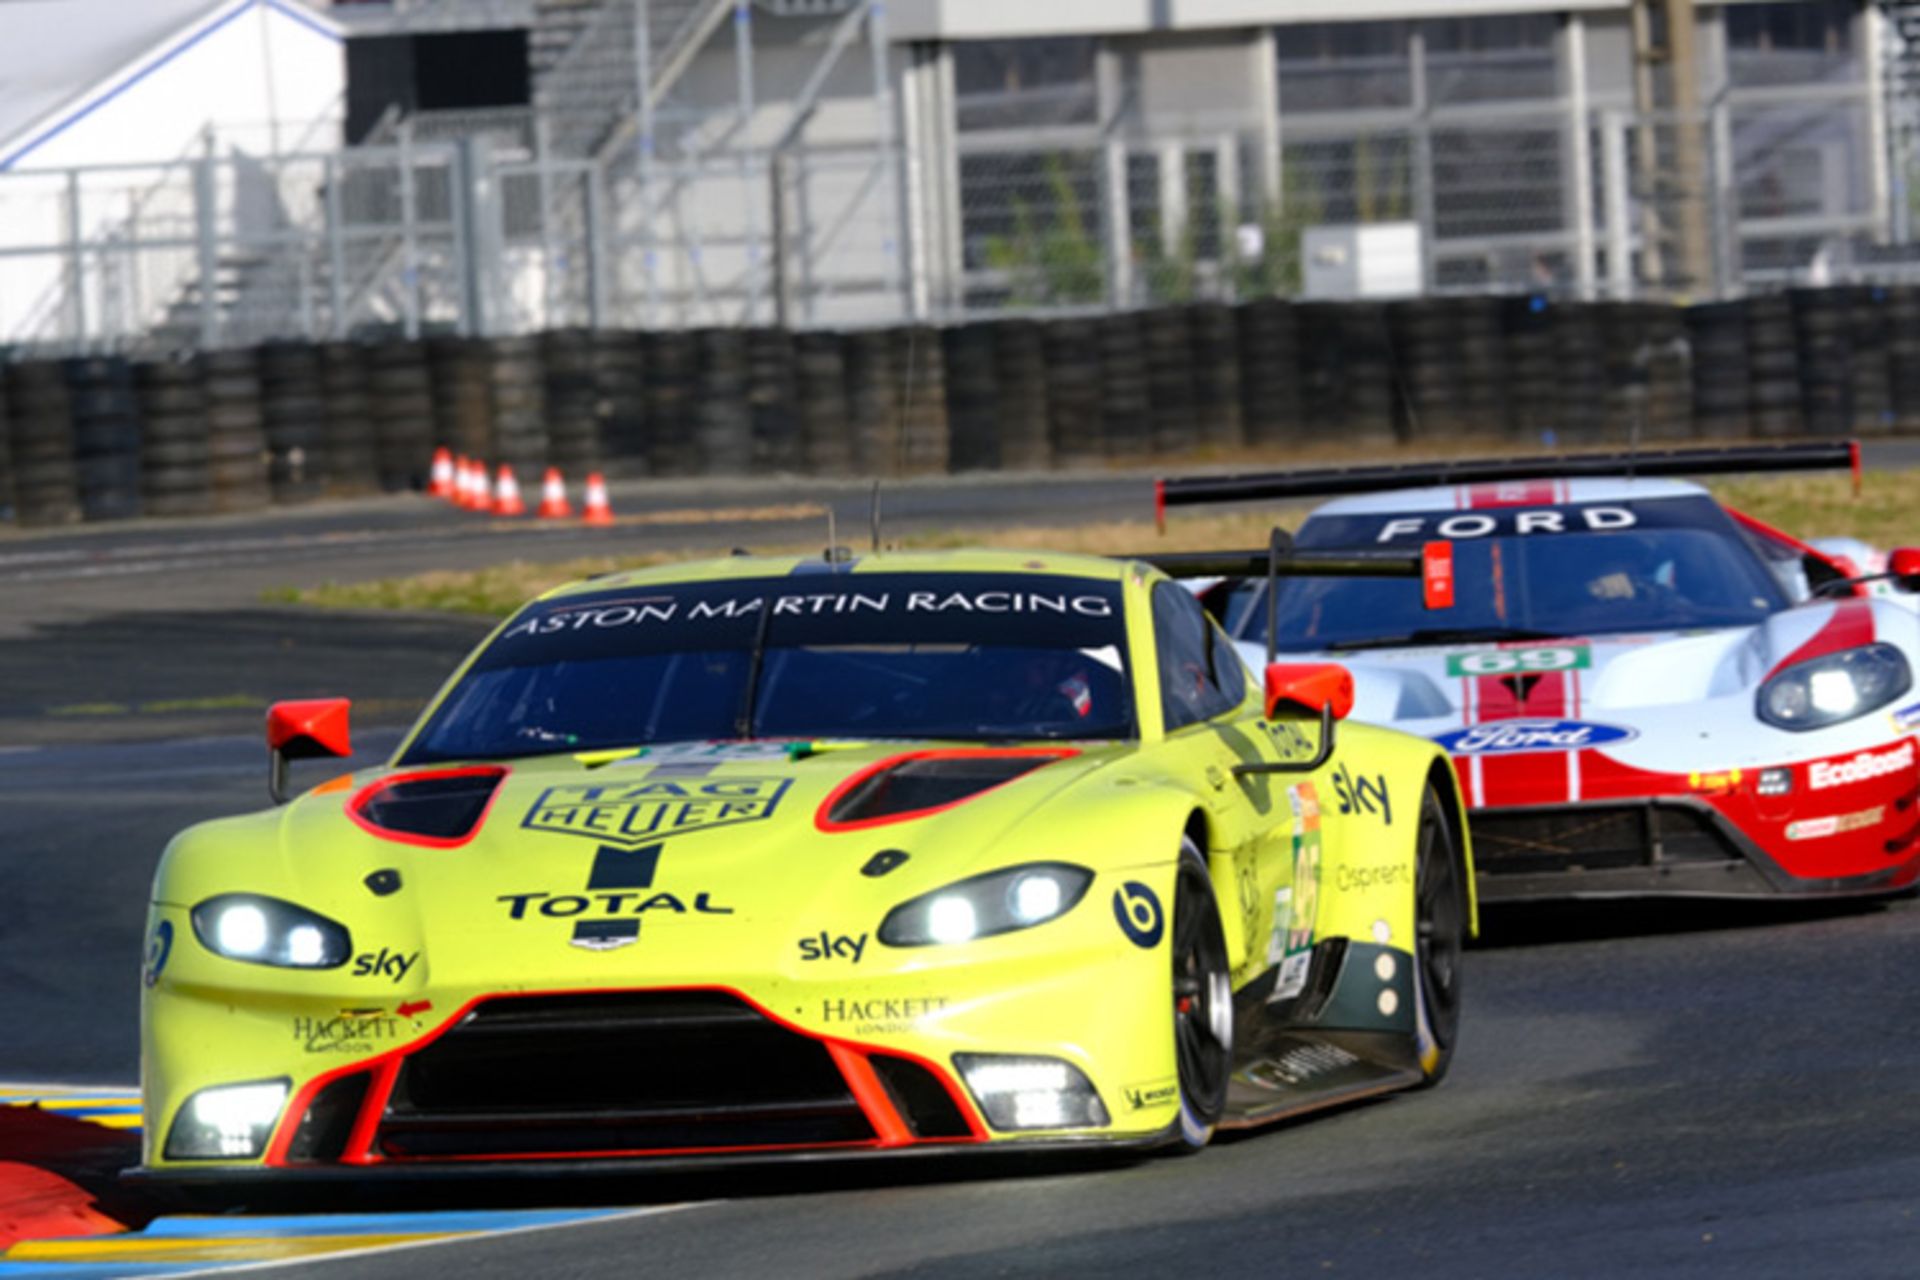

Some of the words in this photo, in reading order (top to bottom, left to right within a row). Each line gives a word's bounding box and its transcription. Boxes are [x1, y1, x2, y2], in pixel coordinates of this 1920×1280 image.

[1377, 507, 1637, 542] FORD
[503, 602, 676, 639] ASTON
[688, 592, 889, 619] MARTIN
[906, 592, 1112, 616] RACING
[1459, 649, 1575, 671] 69
[1456, 721, 1592, 750] Ford
[551, 782, 760, 799] TAG
[1333, 762, 1392, 825] sky
[541, 802, 757, 835] HEUER
[496, 892, 734, 920] TOTAL
[798, 930, 869, 964] sky
[352, 948, 419, 982] sky
